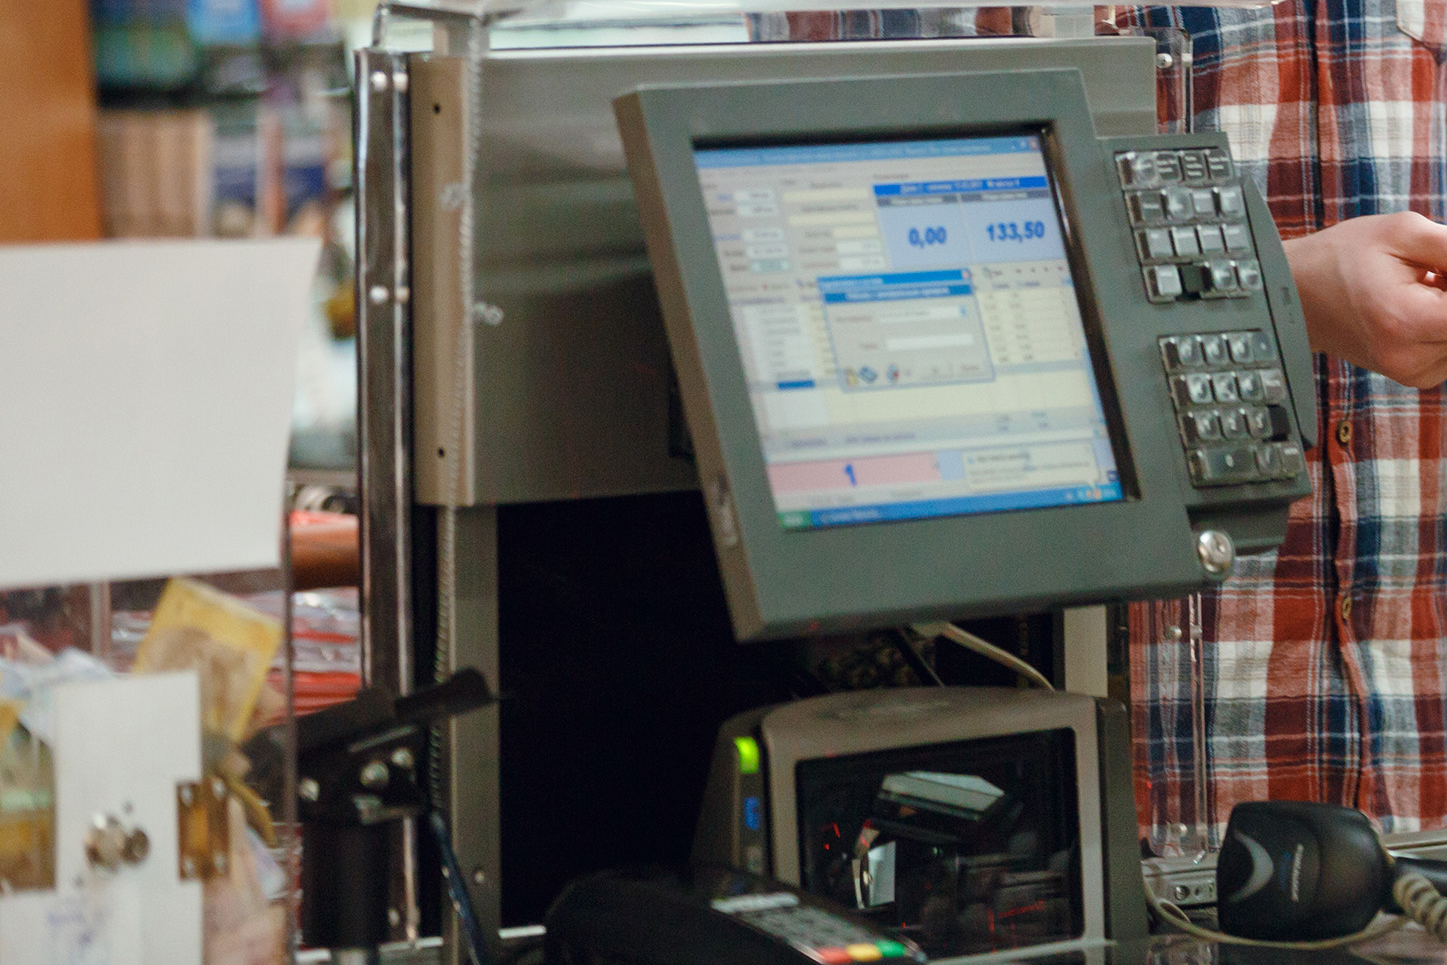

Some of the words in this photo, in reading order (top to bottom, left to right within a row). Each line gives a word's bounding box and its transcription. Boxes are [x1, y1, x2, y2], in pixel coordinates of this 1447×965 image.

[909, 226, 946, 247] 0,00
[987, 222, 1045, 242] 133,50
[843, 464, 857, 487] 1
